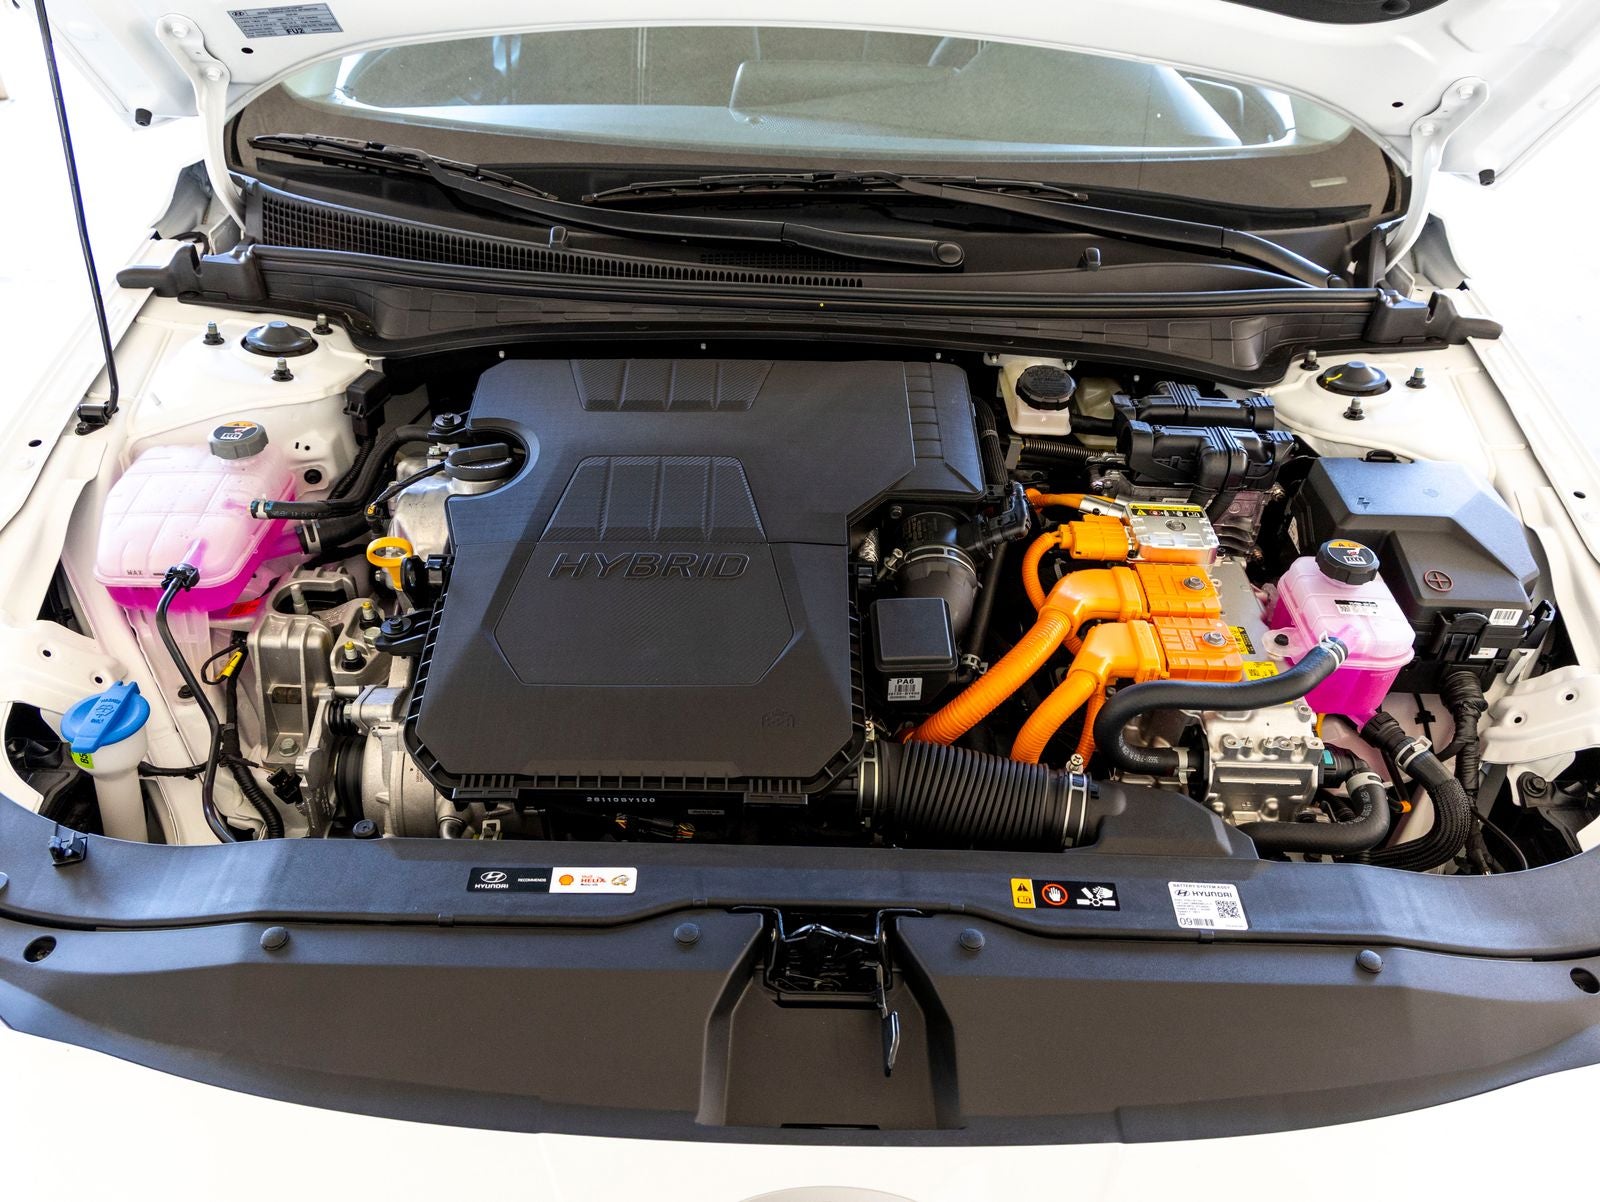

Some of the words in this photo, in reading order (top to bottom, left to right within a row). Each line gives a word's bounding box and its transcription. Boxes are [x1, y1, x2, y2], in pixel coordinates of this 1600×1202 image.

[286, 27, 306, 35] FU2
[548, 552, 750, 579] HYBRID
[1192, 890, 1233, 898] HYUNDAI
[1179, 917, 1193, 926] 09
